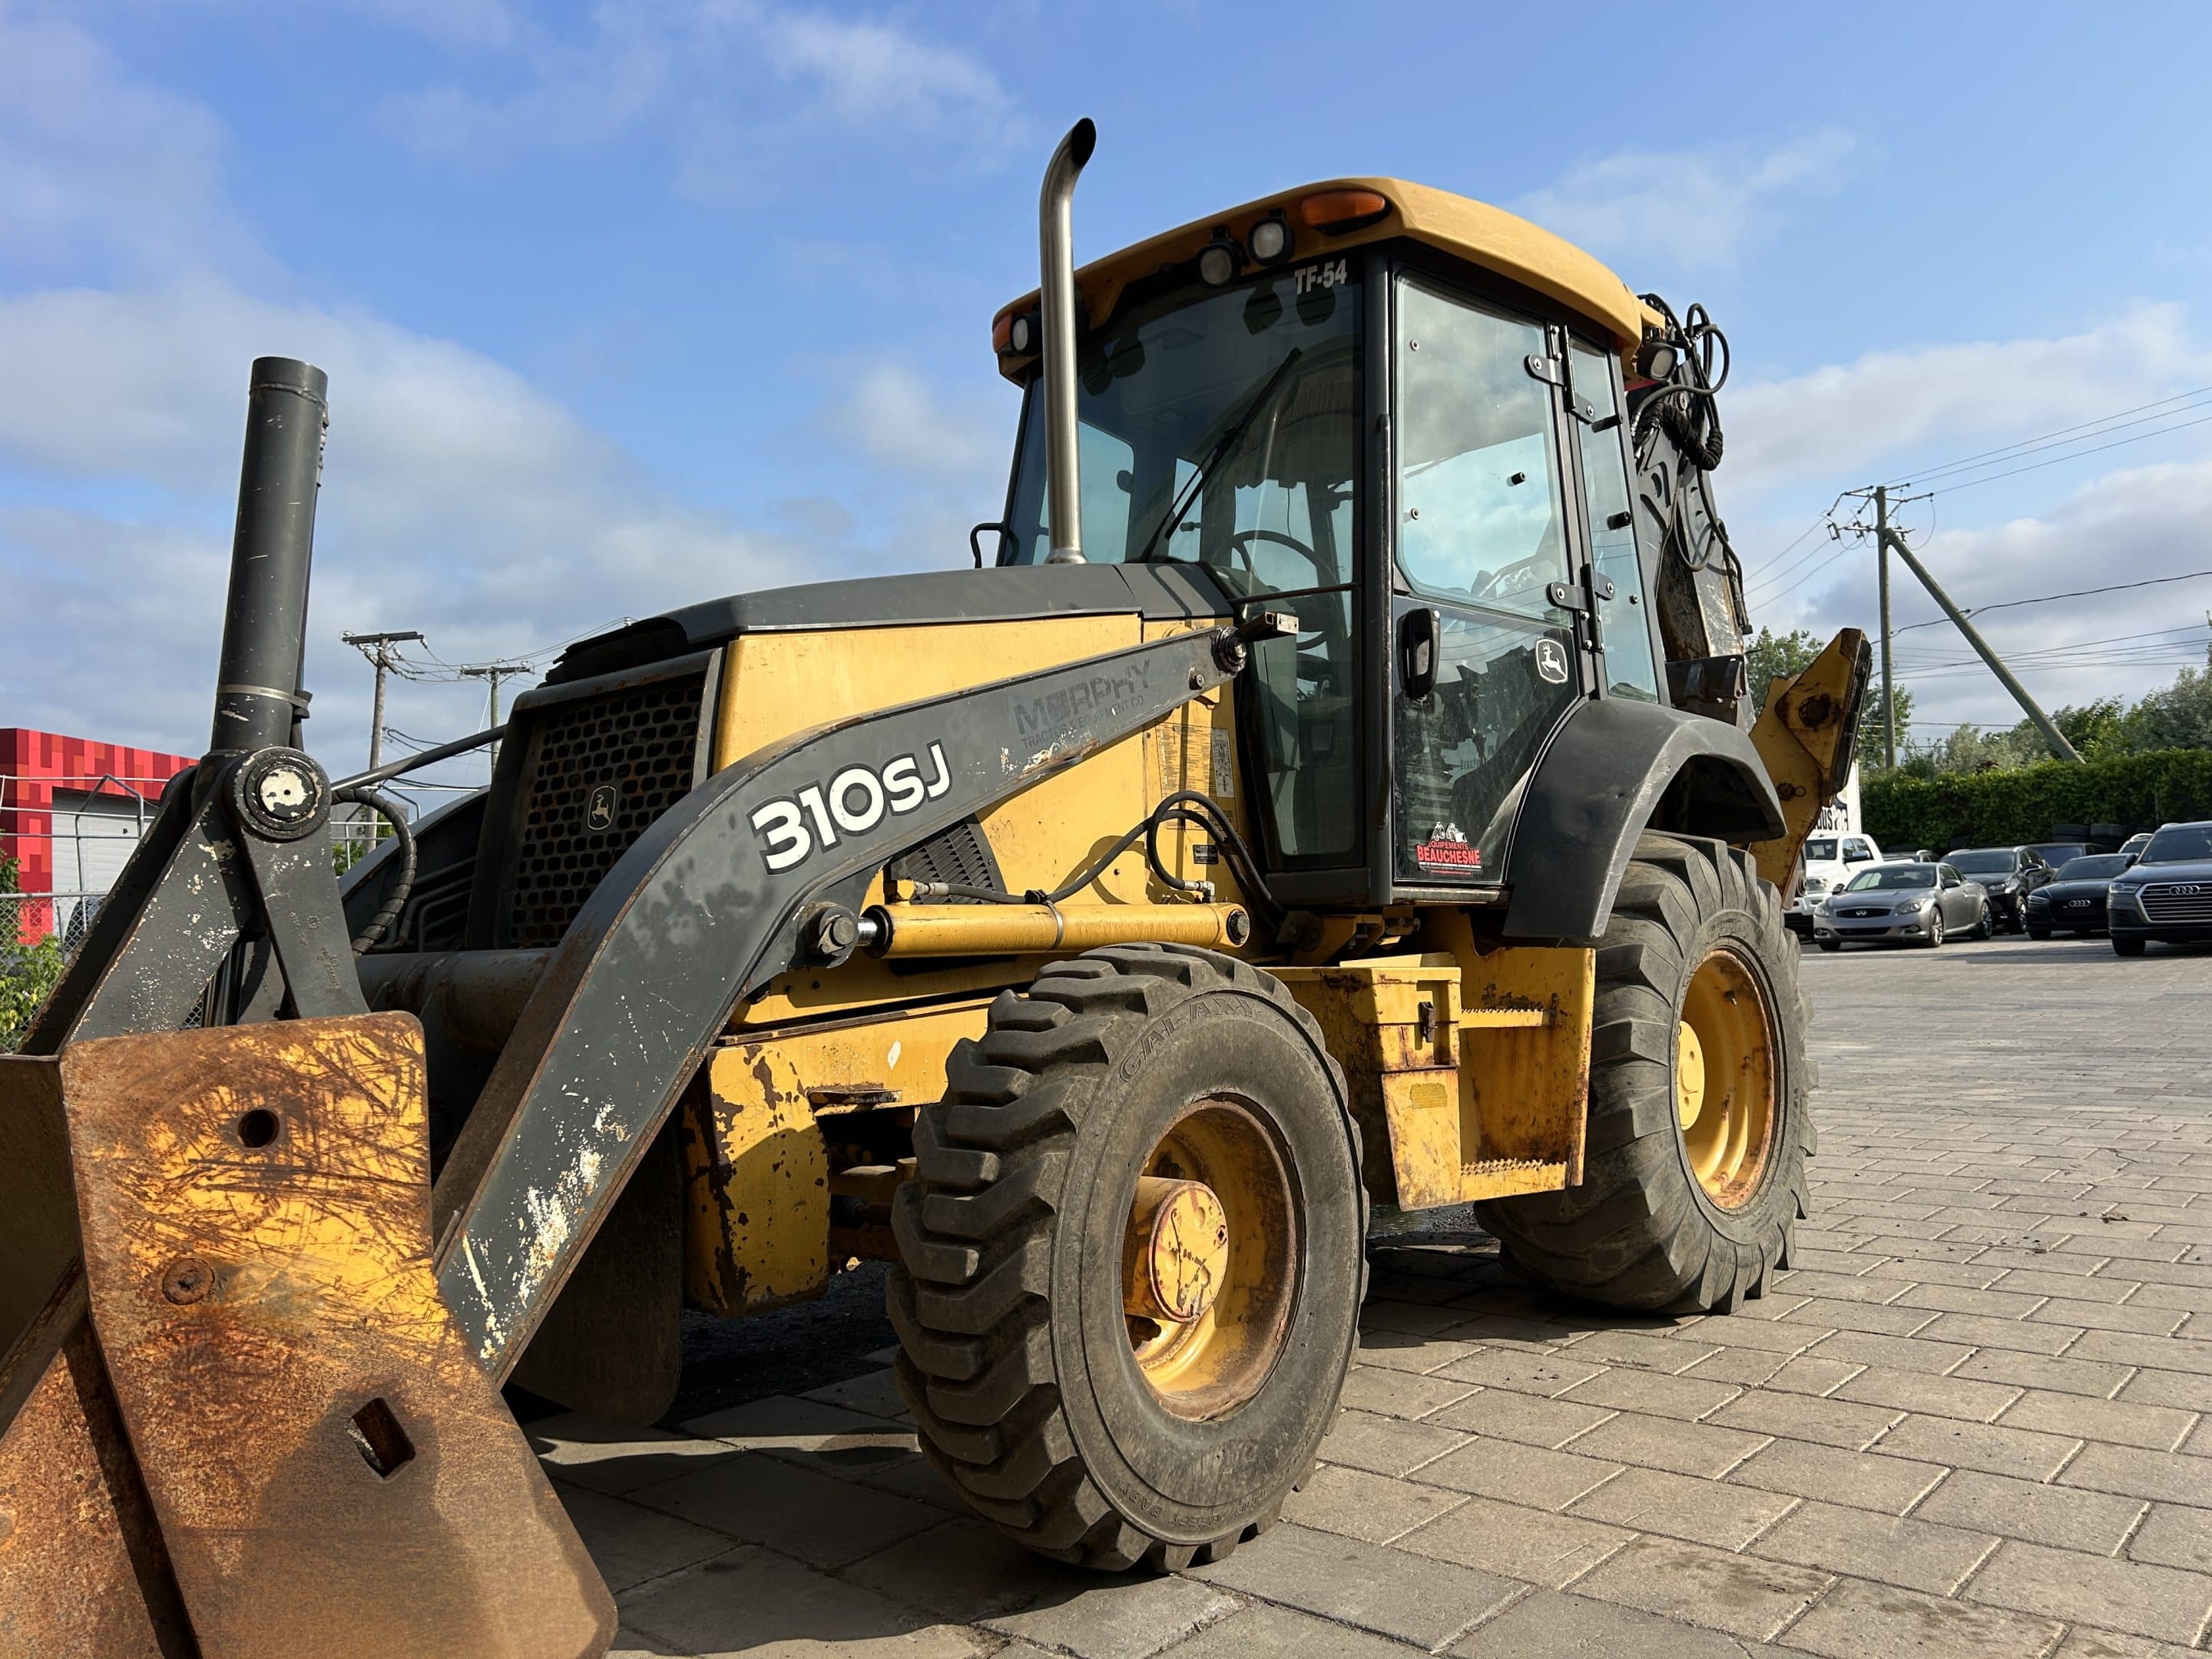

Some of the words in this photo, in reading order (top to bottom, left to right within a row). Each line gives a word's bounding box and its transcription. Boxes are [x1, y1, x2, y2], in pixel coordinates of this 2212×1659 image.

[1294, 259, 1347, 295] TF-54
[747, 740, 952, 873] 310SJ
[1416, 846, 1481, 865] BEAUCHESNE
[1119, 996, 1257, 1083] GALAXY
